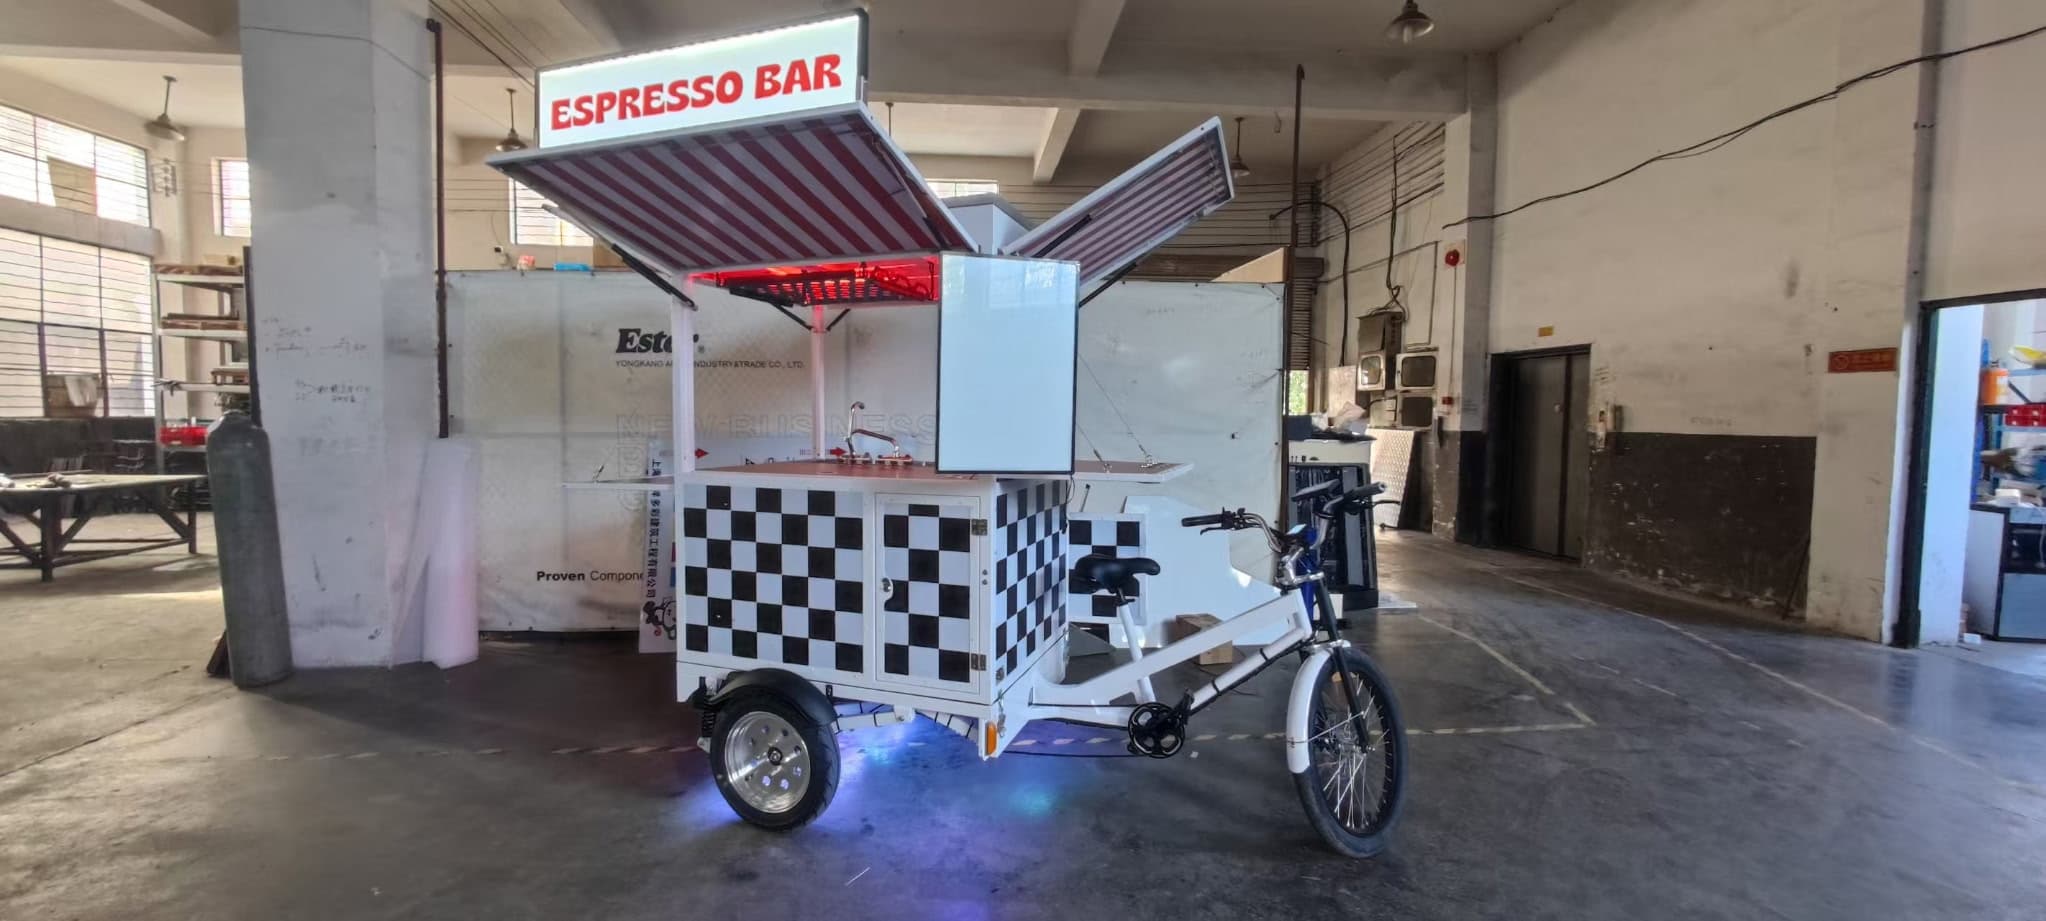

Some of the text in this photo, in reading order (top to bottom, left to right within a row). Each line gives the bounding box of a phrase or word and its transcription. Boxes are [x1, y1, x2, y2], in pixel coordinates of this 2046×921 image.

[551, 54, 842, 130] ESPRESSO BAR
[615, 328, 699, 353] Este
[537, 571, 585, 581] Proven
